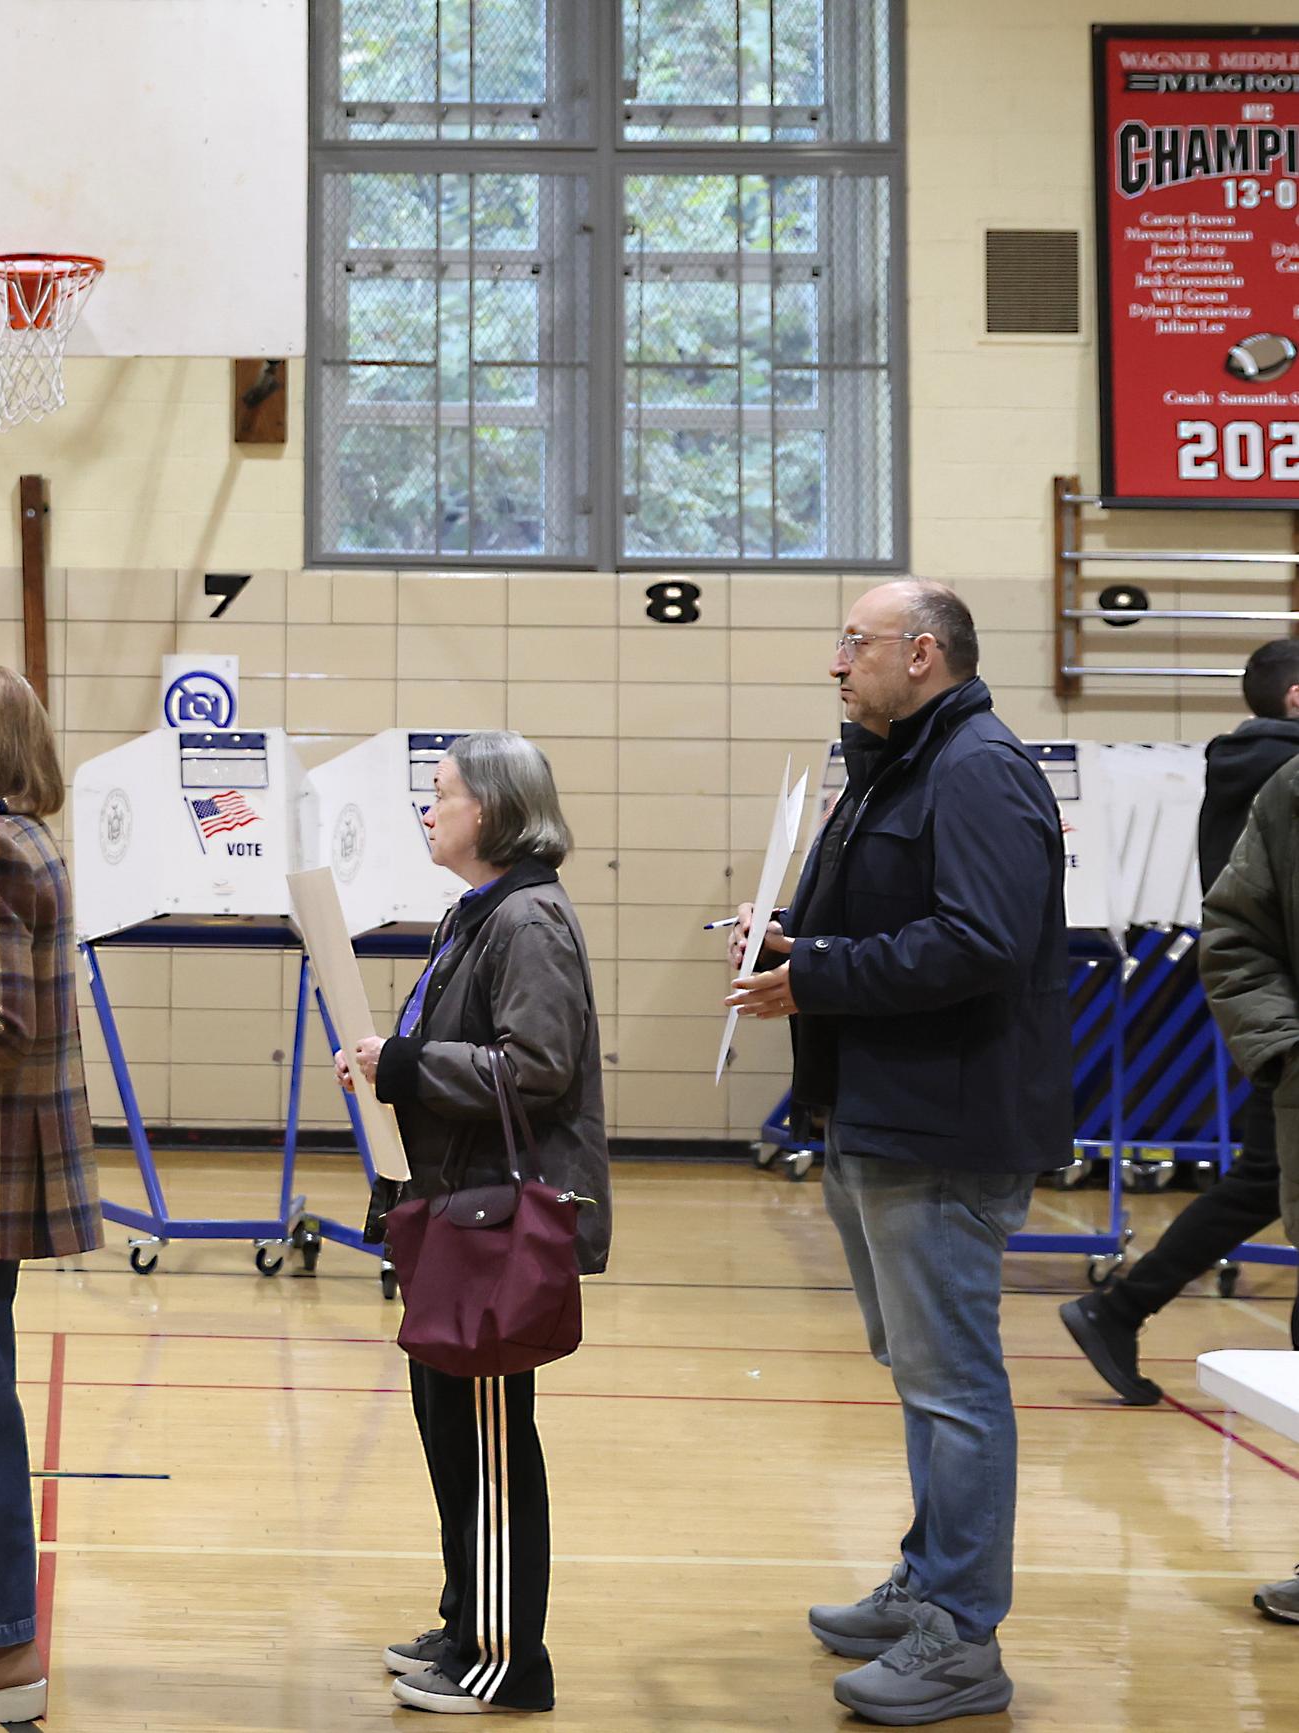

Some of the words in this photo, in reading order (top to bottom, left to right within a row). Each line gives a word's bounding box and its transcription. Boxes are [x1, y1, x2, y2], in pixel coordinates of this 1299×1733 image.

[1120, 52, 1211, 70] WAGNER
[1157, 74, 1182, 92] JV
[1114, 119, 1299, 199] CHAMPI
[1222, 178, 1297, 209] 13-0
[1176, 420, 1299, 481] 202
[204, 574, 251, 617] 7
[646, 581, 701, 624] 8
[227, 842, 263, 856] VOTE
